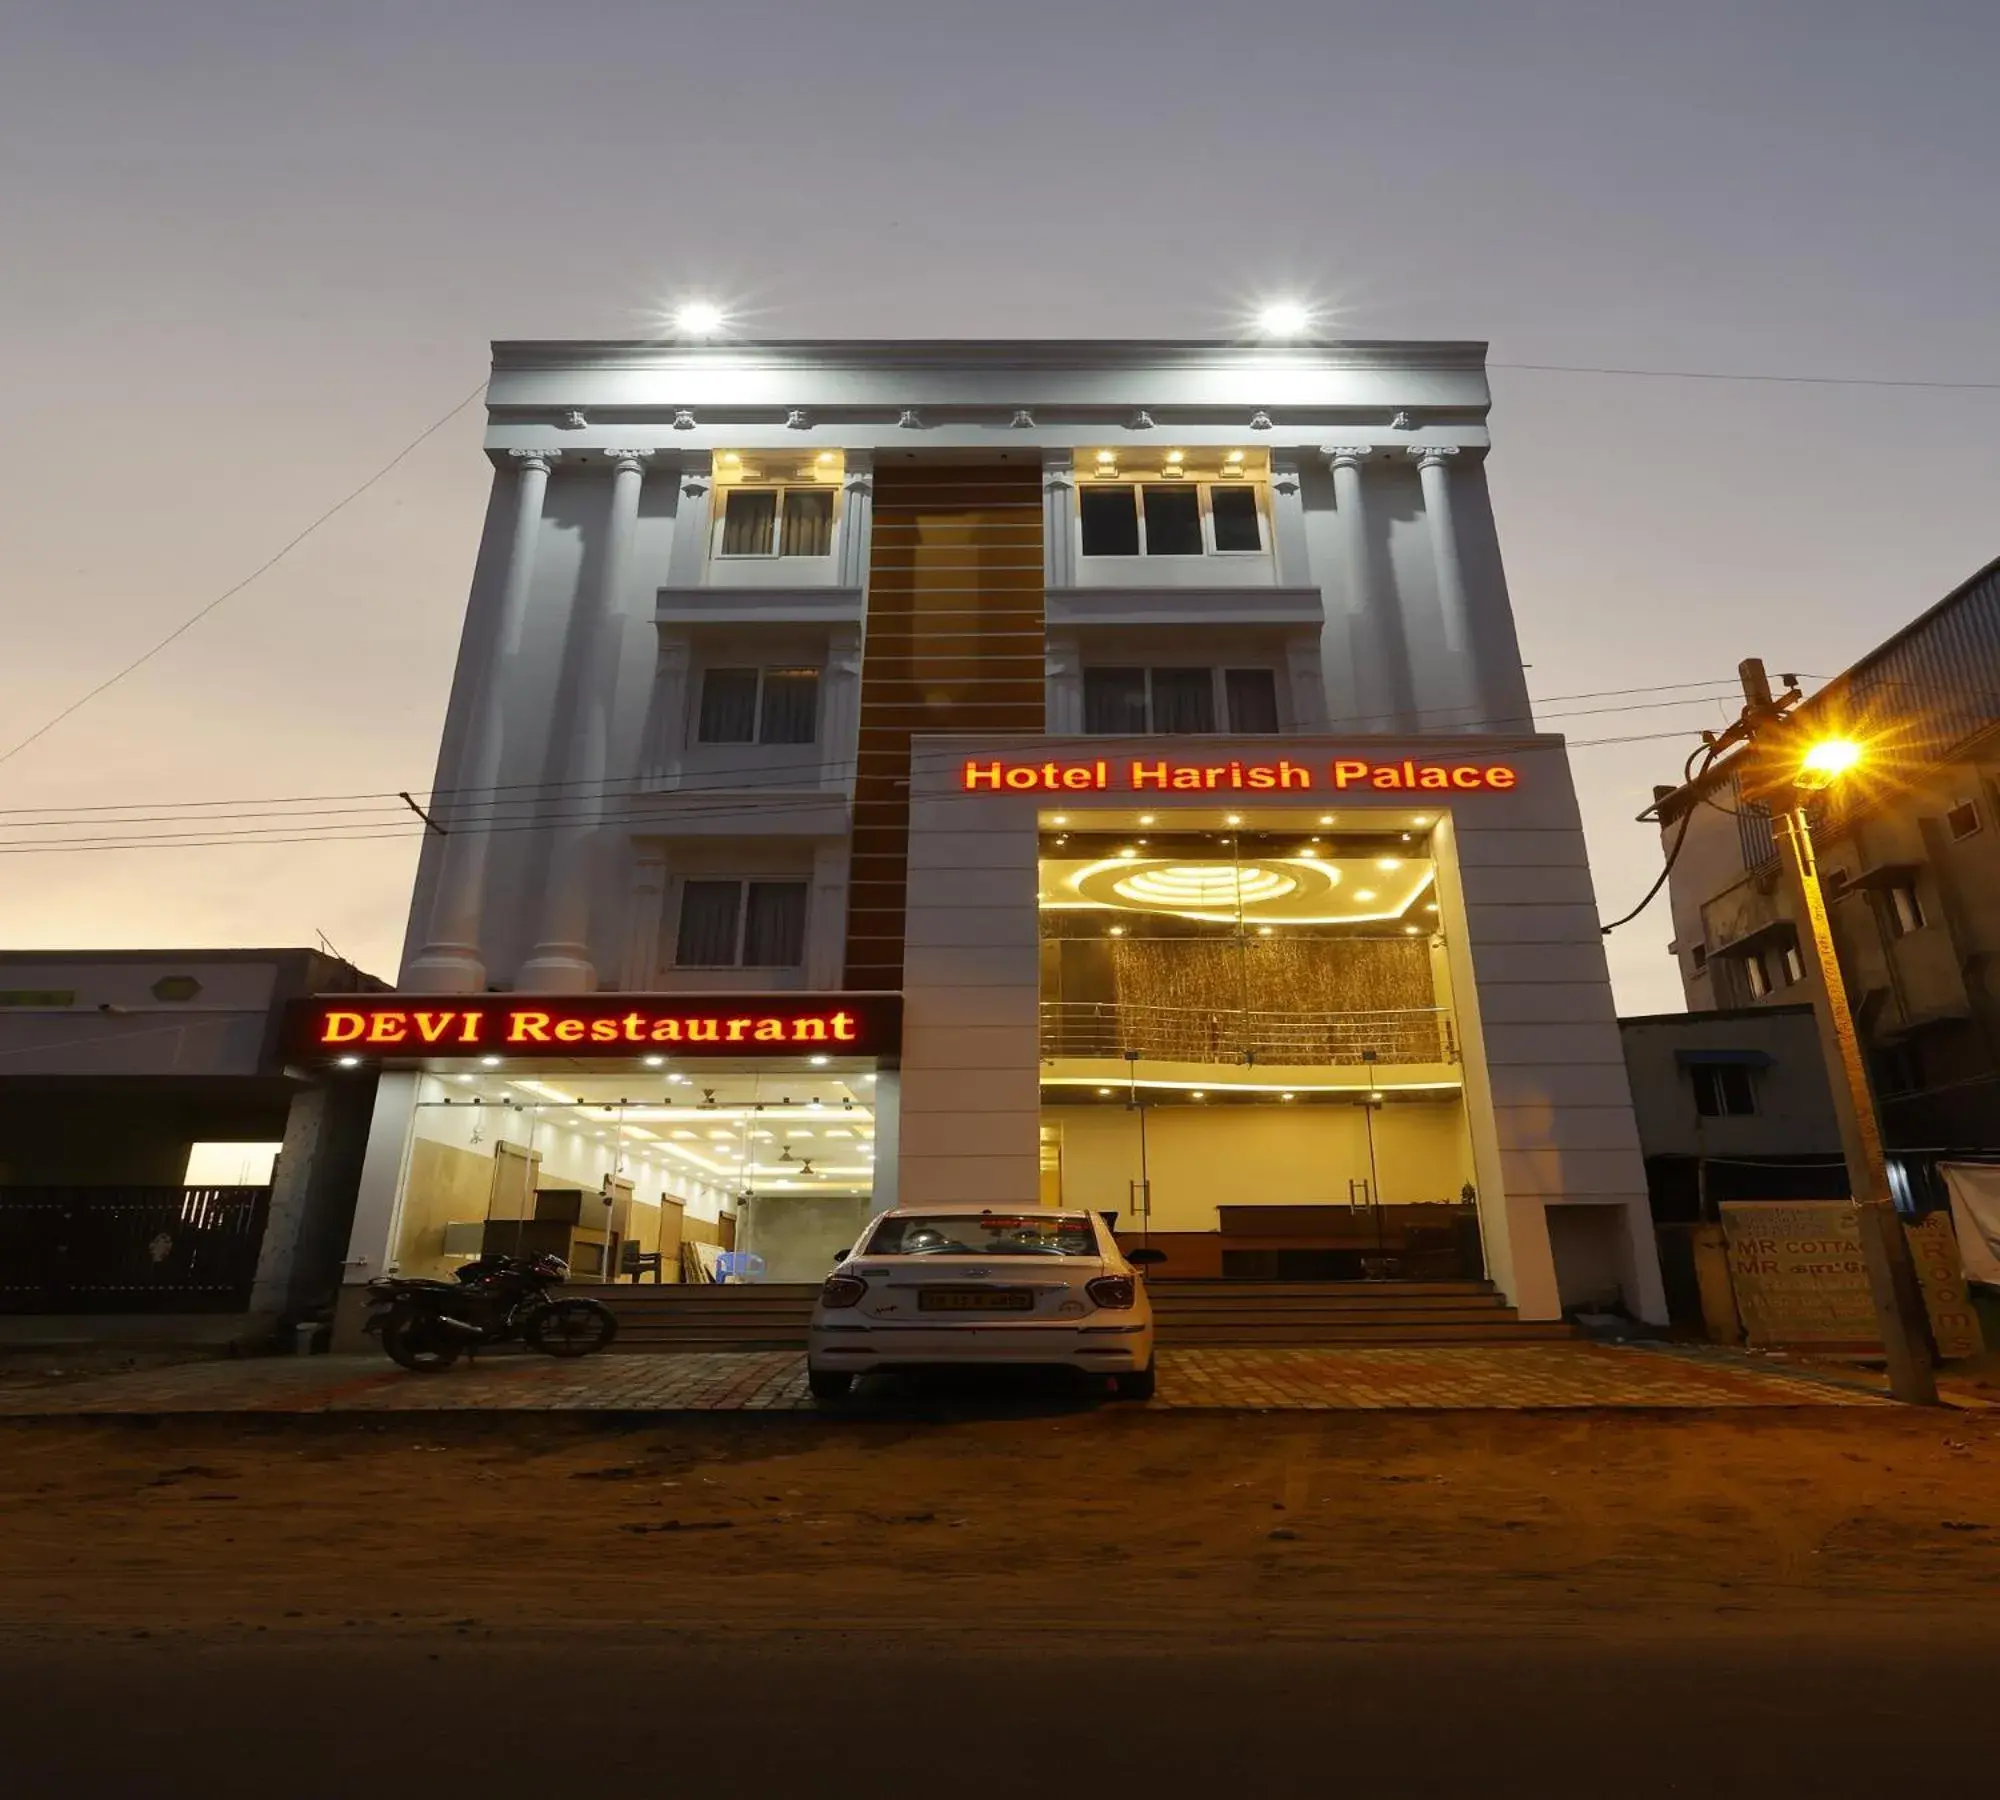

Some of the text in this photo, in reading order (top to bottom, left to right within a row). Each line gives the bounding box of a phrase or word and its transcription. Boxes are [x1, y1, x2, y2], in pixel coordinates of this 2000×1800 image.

[965, 761, 1515, 789] Hotel Harish Palace
[320, 1012, 855, 1042] DEVI Restaurant
[1737, 1240, 1863, 1255] MR COTTA
[1738, 1260, 1781, 1275] MR
